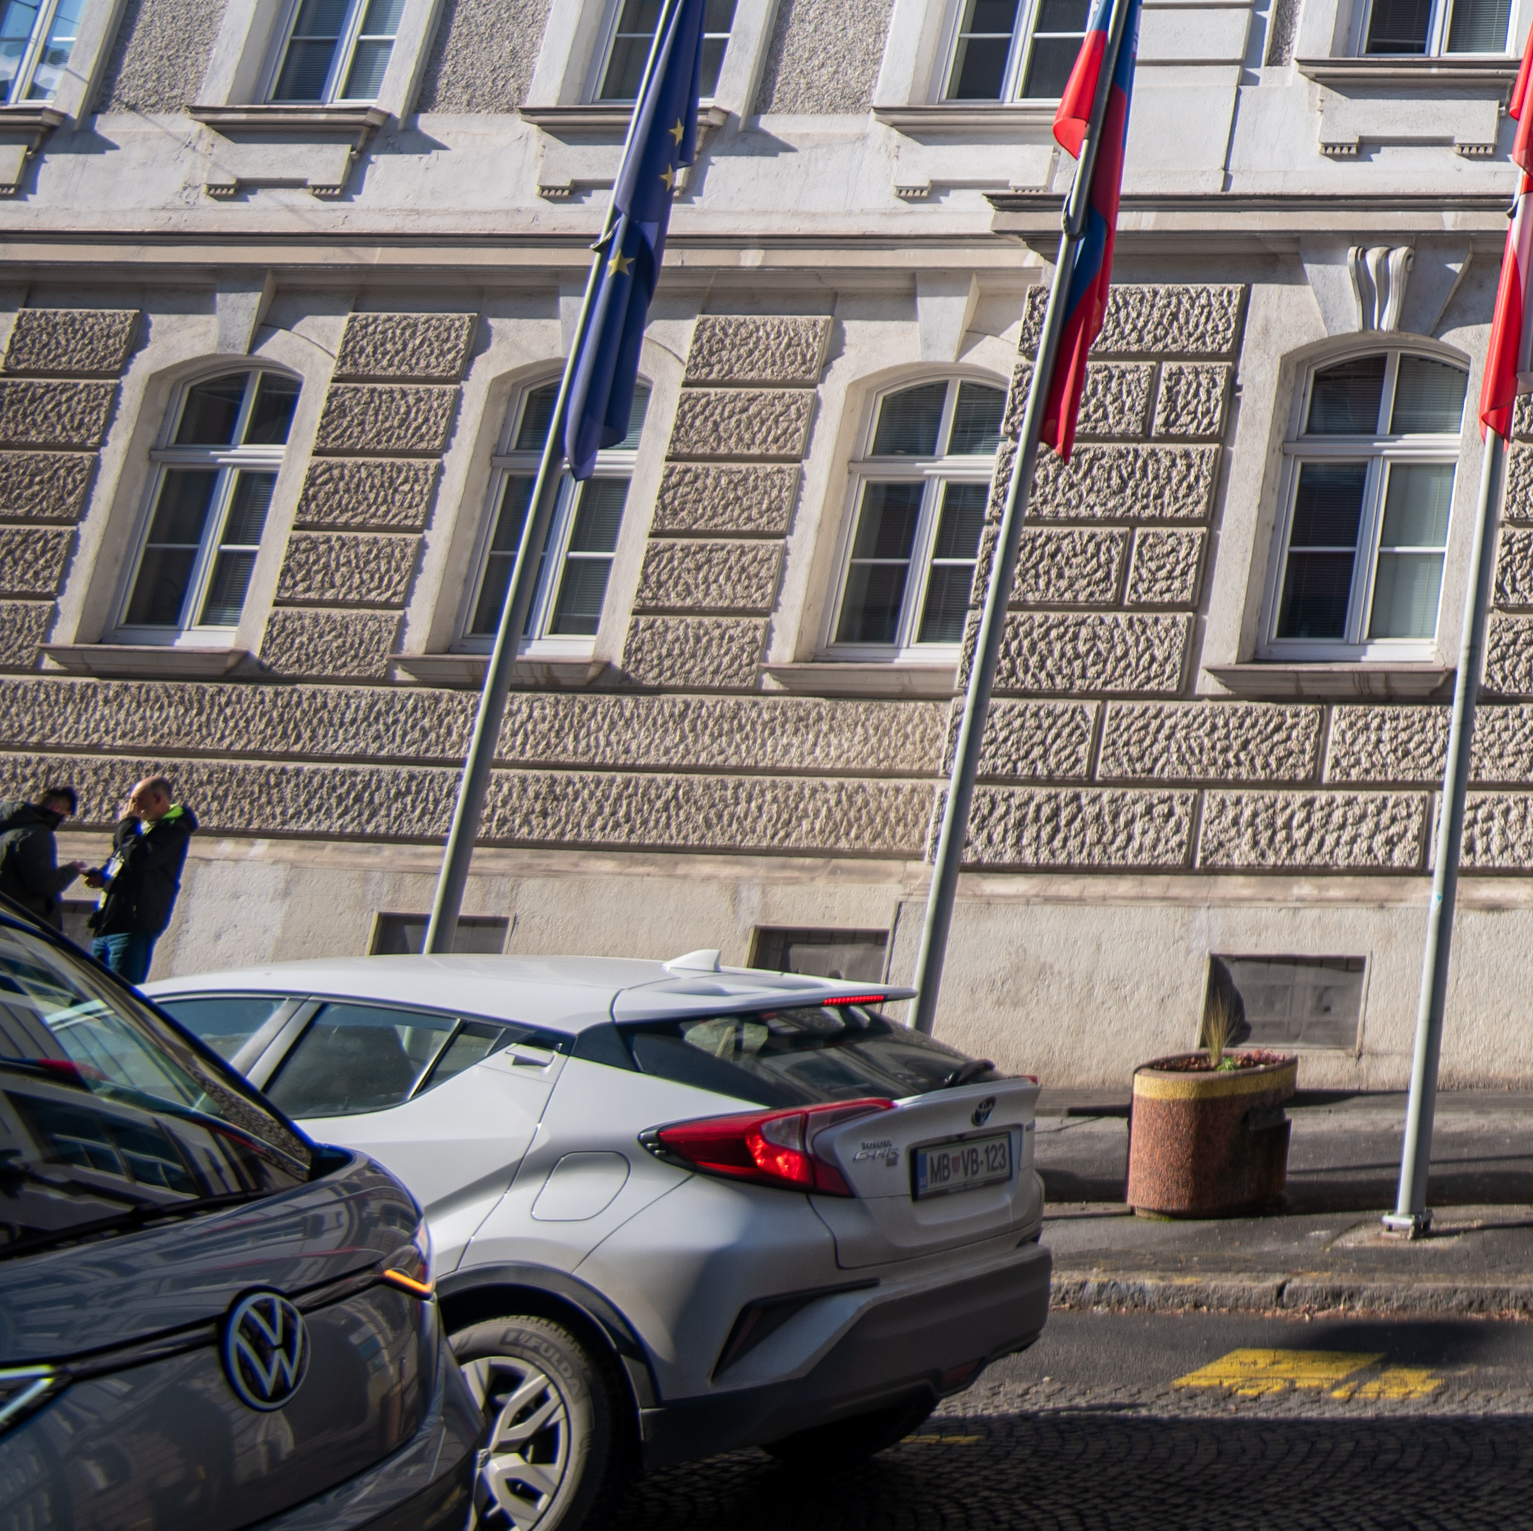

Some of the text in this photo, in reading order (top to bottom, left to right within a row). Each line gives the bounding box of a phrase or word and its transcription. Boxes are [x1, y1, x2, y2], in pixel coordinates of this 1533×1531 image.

[929, 1142, 1007, 1184] MB VB-123
[529, 1338, 582, 1397] FULDA
